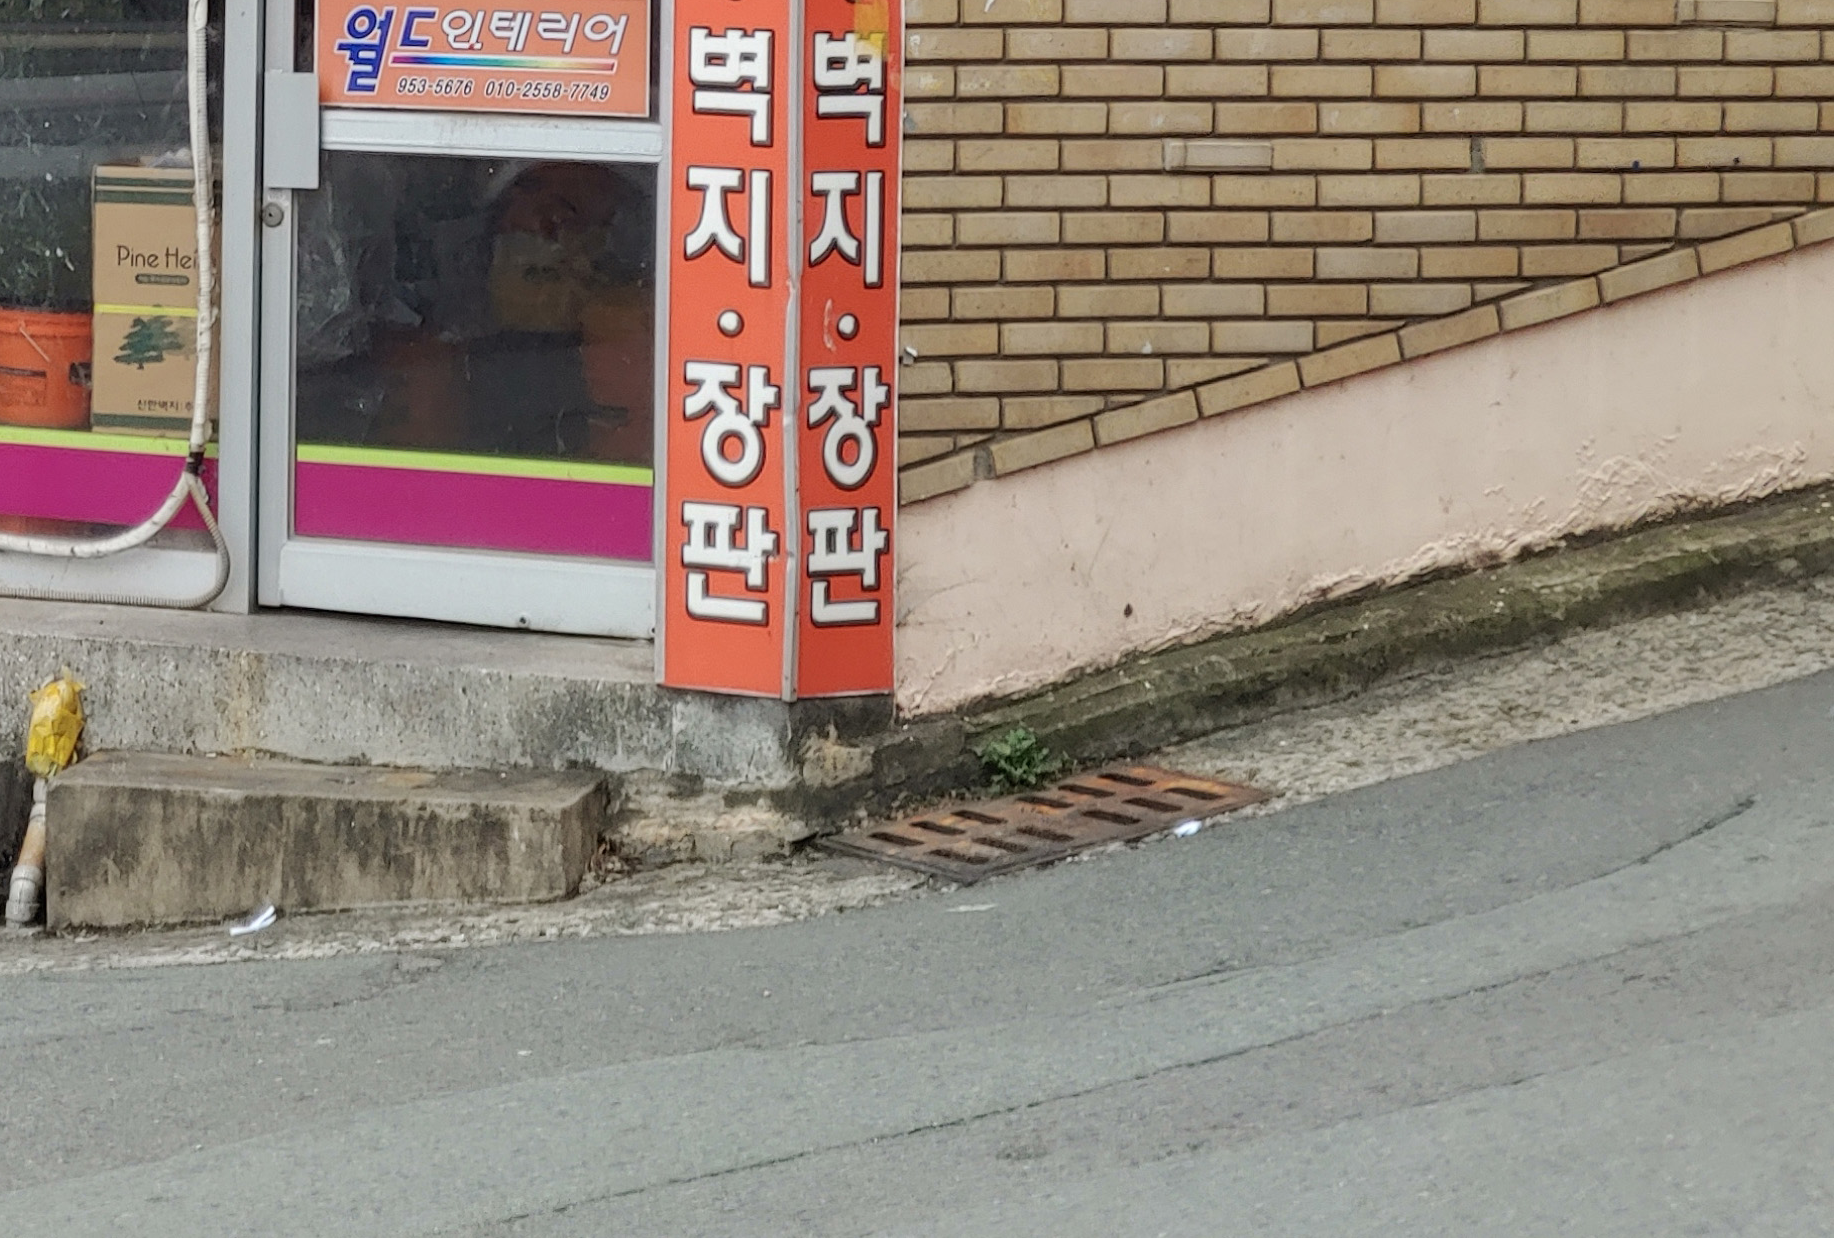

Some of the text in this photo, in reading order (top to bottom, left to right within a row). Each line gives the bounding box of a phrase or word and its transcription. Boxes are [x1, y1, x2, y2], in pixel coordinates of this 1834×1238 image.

[333, 4, 629, 95] 월드인테리어
[396, 77, 611, 101] 953-5676 010-2558-7749
[115, 244, 159, 269] Pine
